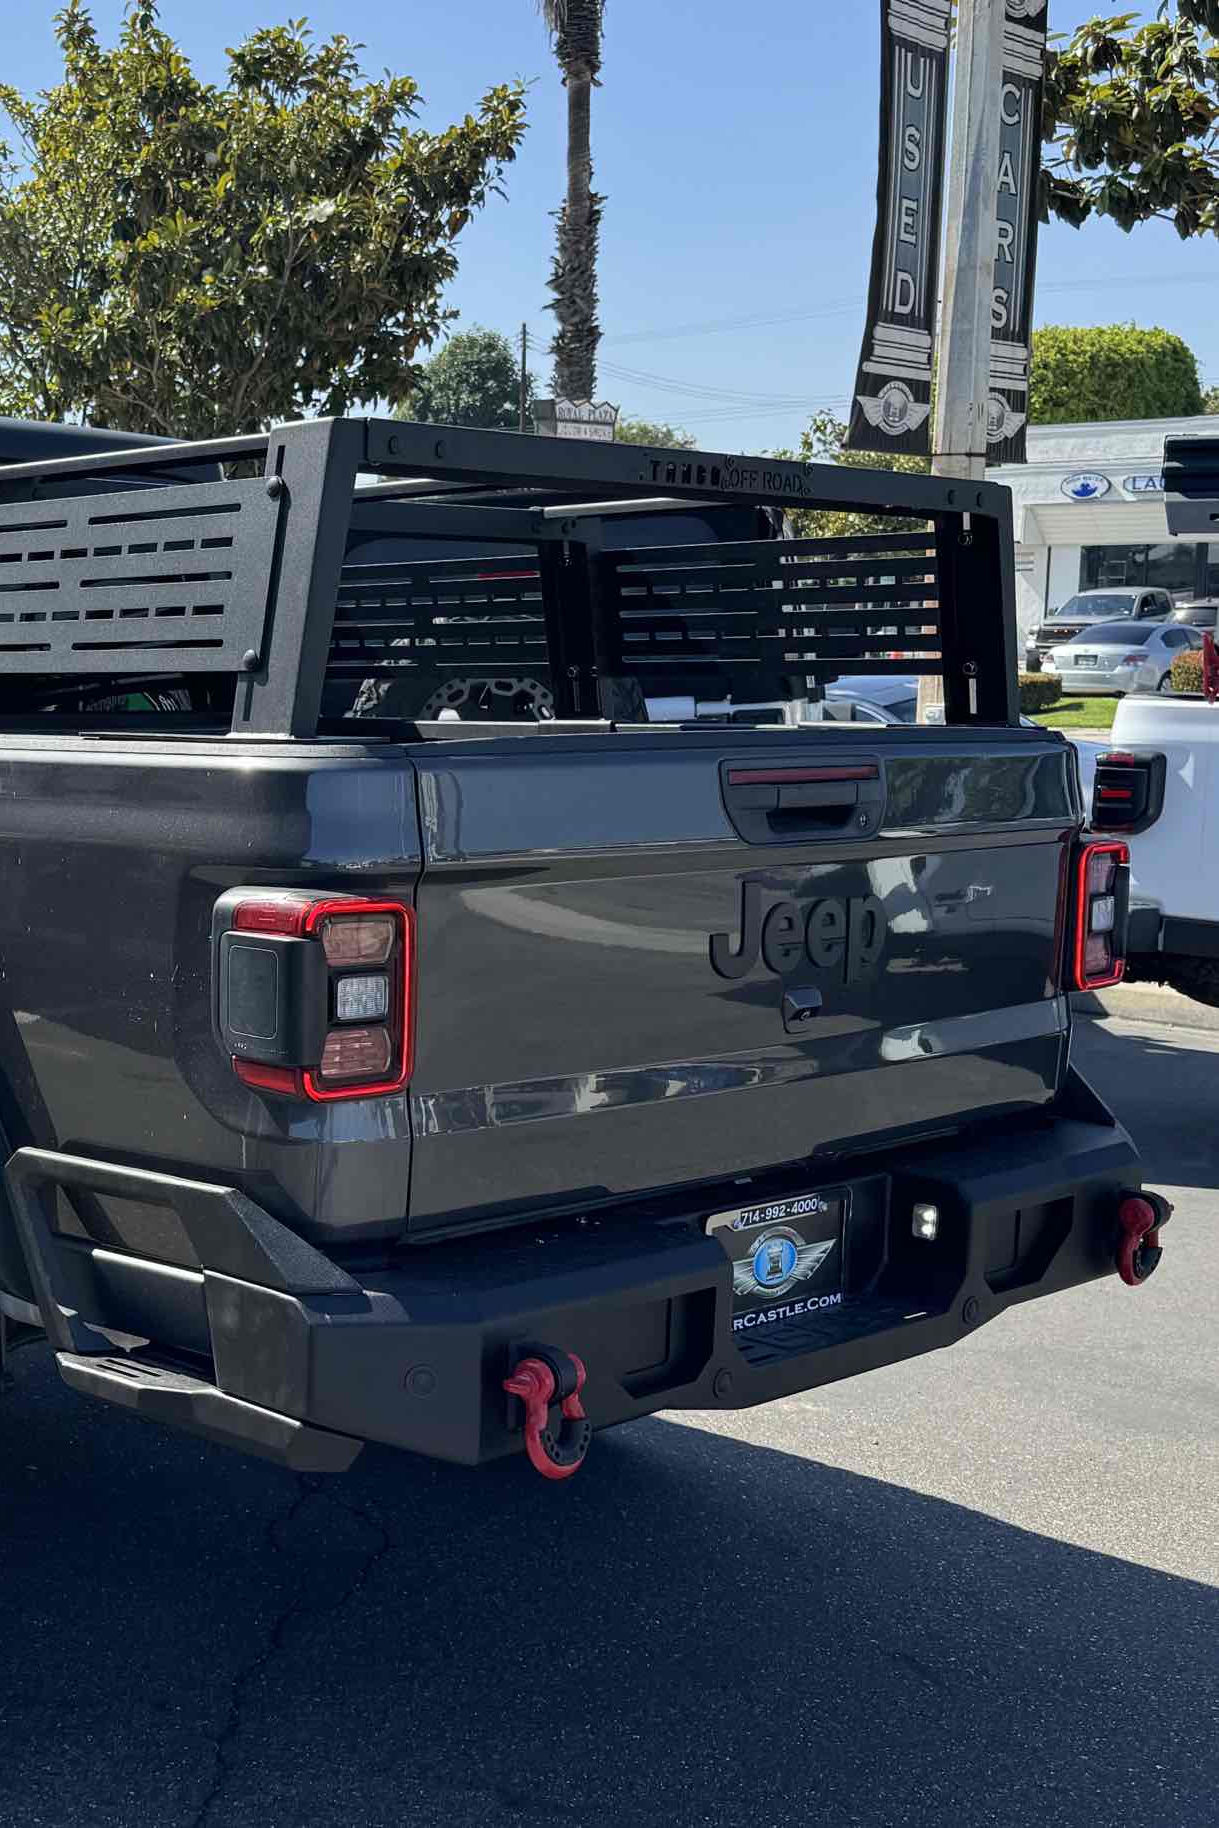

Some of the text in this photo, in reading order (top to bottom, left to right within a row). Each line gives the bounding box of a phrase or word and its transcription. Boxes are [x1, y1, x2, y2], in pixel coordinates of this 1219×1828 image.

[894, 50, 925, 315] USED
[990, 82, 1021, 329] CARS
[730, 468, 758, 490] OFF
[762, 471, 805, 494] ROAD
[709, 876, 885, 986] Jeep
[741, 1198, 818, 1225] 714-992-4000
[732, 1293, 842, 1332] RCASTLE.COM
